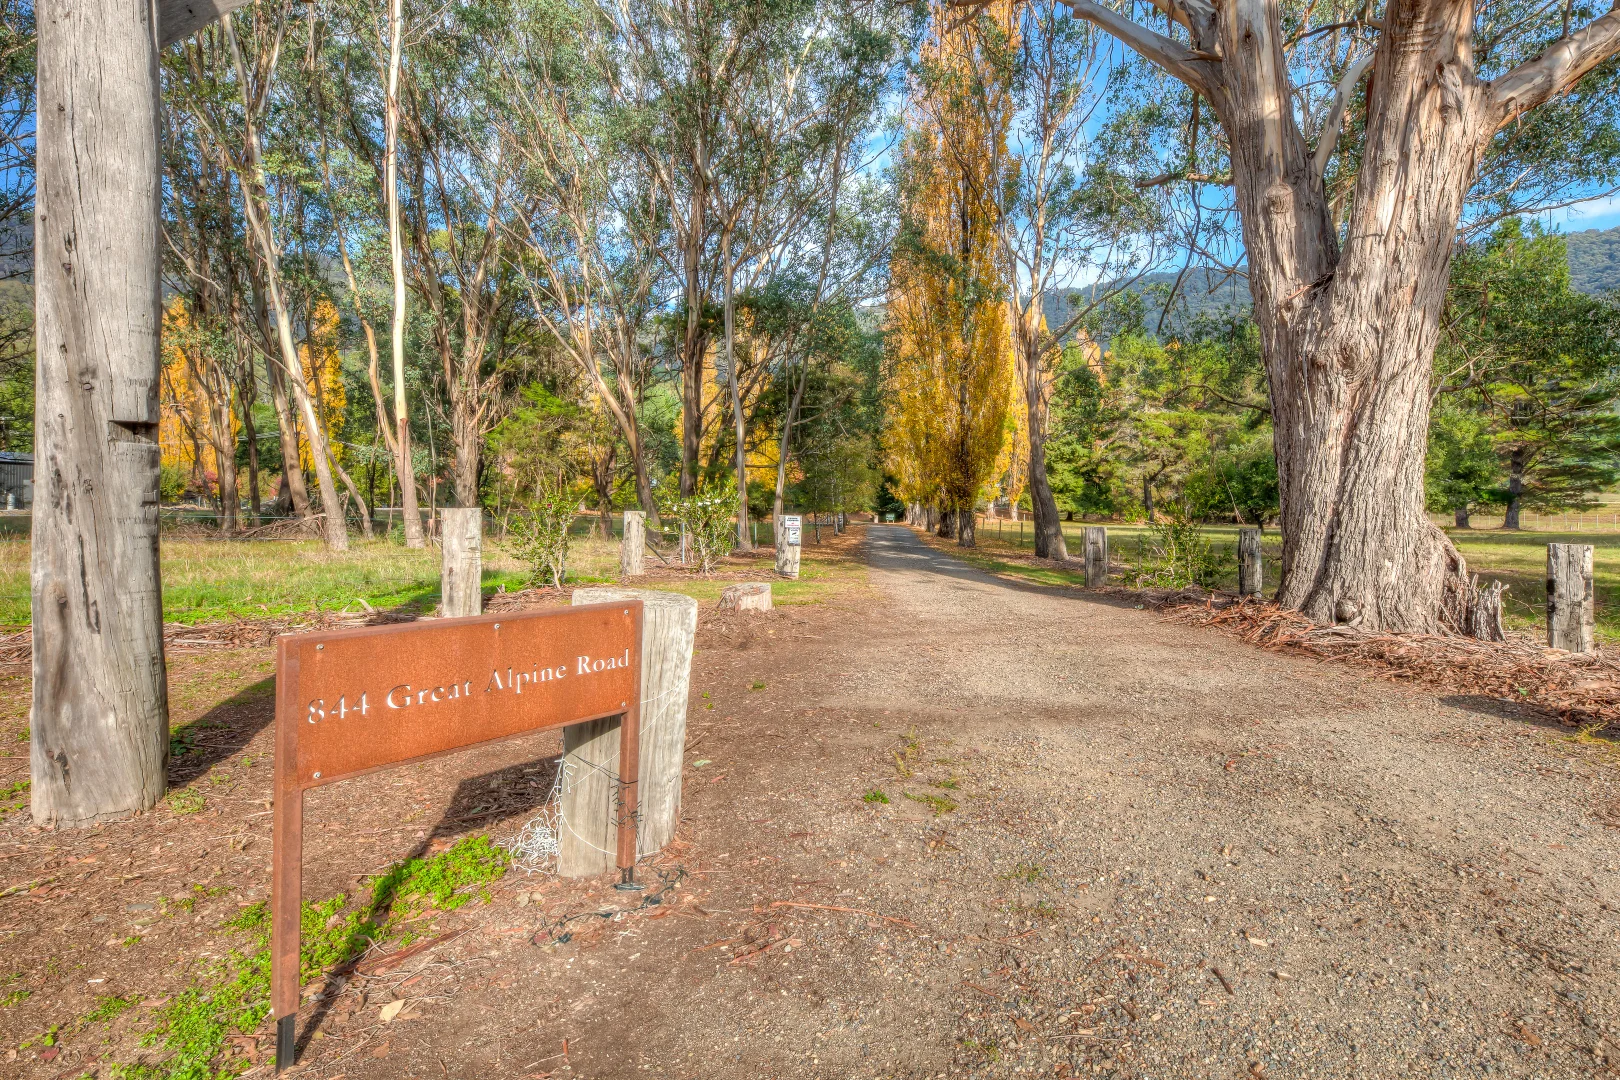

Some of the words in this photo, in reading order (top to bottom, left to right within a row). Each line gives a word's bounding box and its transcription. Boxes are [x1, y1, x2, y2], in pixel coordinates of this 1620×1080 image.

[307, 690, 371, 725] 844
[386, 680, 473, 710] Great
[485, 662, 568, 693] Alpine
[575, 648, 630, 676] Road
